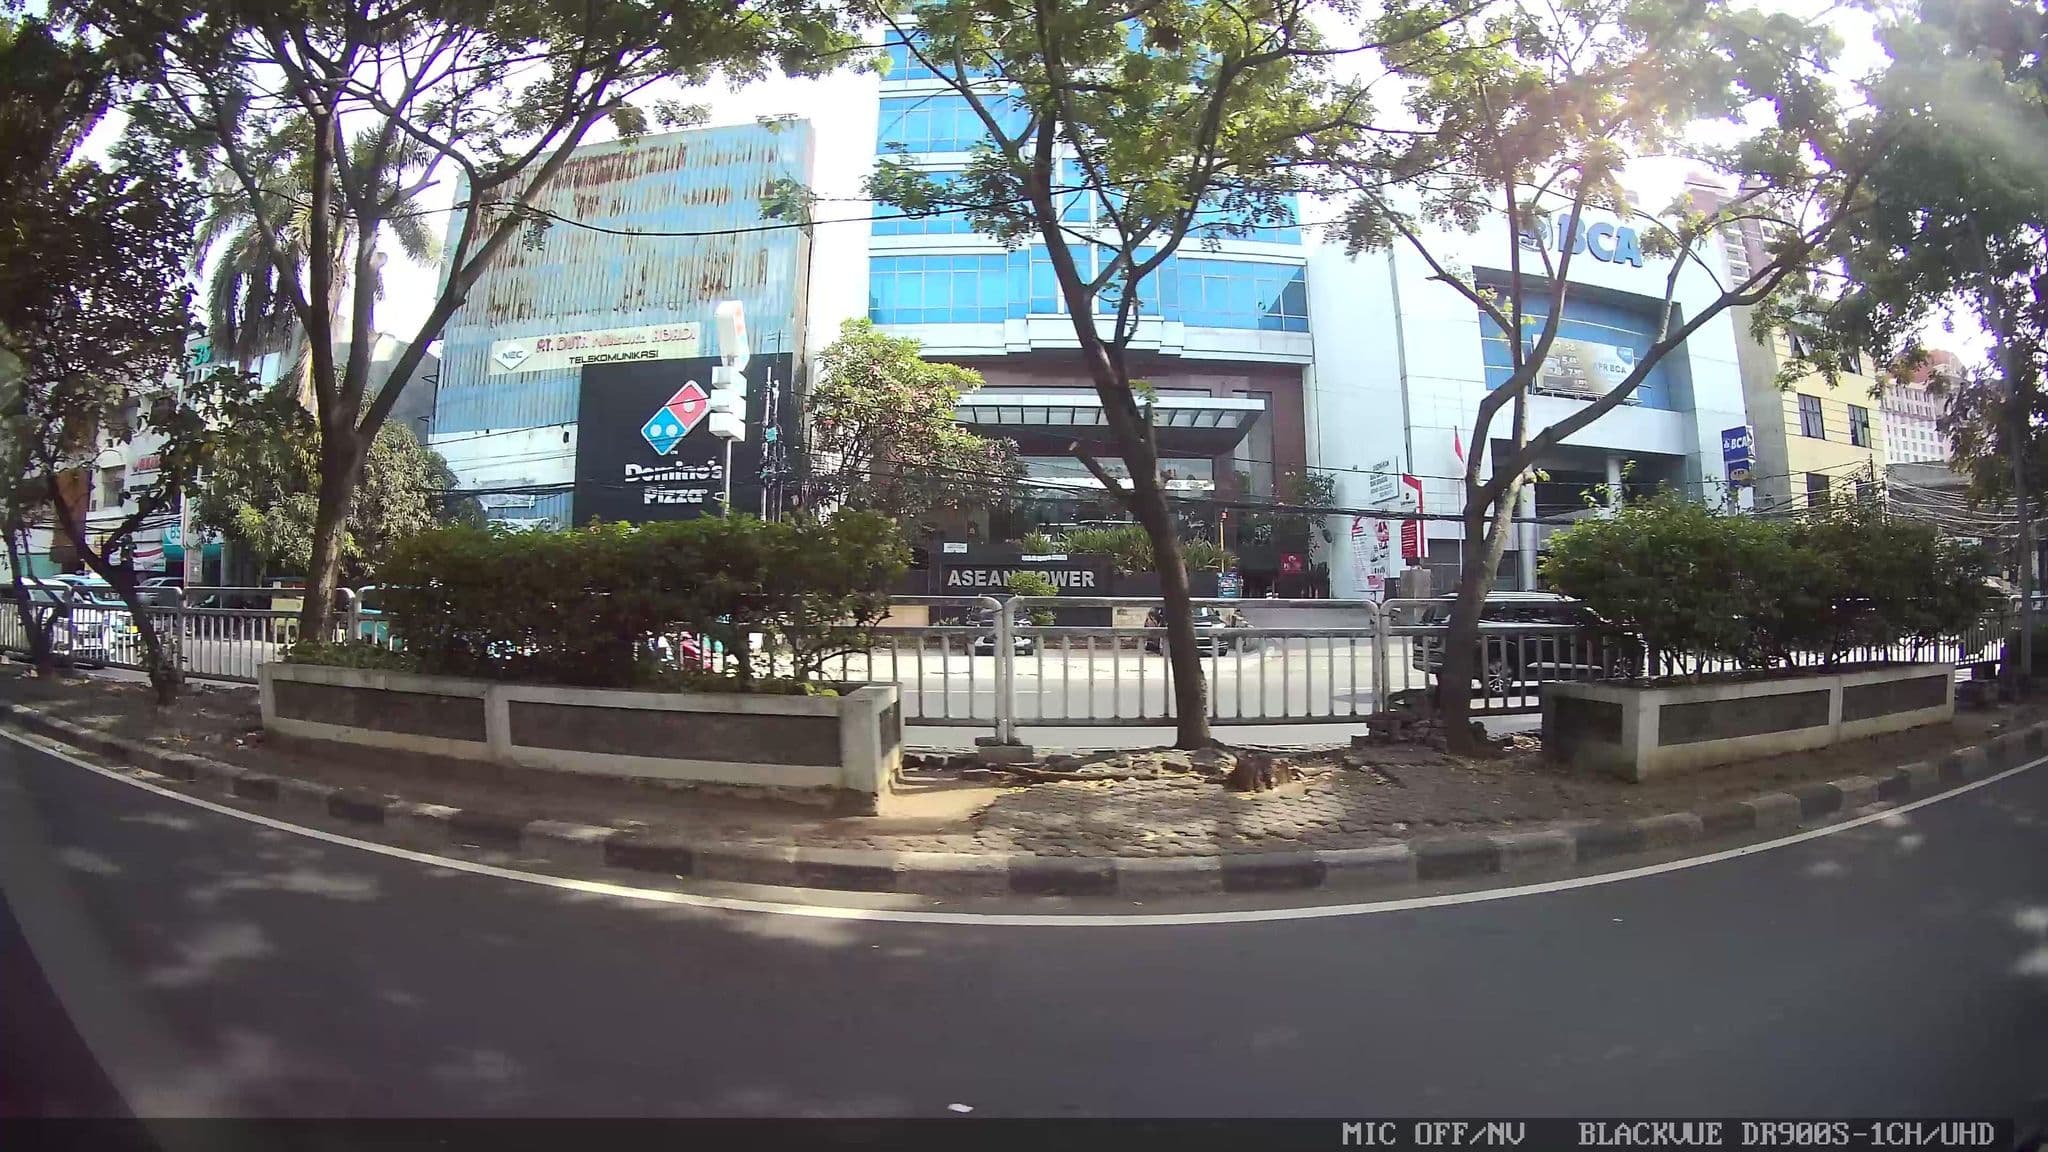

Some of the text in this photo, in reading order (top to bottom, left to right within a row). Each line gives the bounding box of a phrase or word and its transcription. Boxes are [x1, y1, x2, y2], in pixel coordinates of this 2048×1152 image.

[1558, 213, 1643, 268] BCA
[502, 350, 524, 360] NEC
[569, 350, 659, 365] TELEKOMUNIKASI
[1731, 435, 1748, 450] BCA
[624, 460, 723, 482] Domino's
[643, 484, 708, 505] Pizza
[947, 569, 1016, 587] ASEAN
